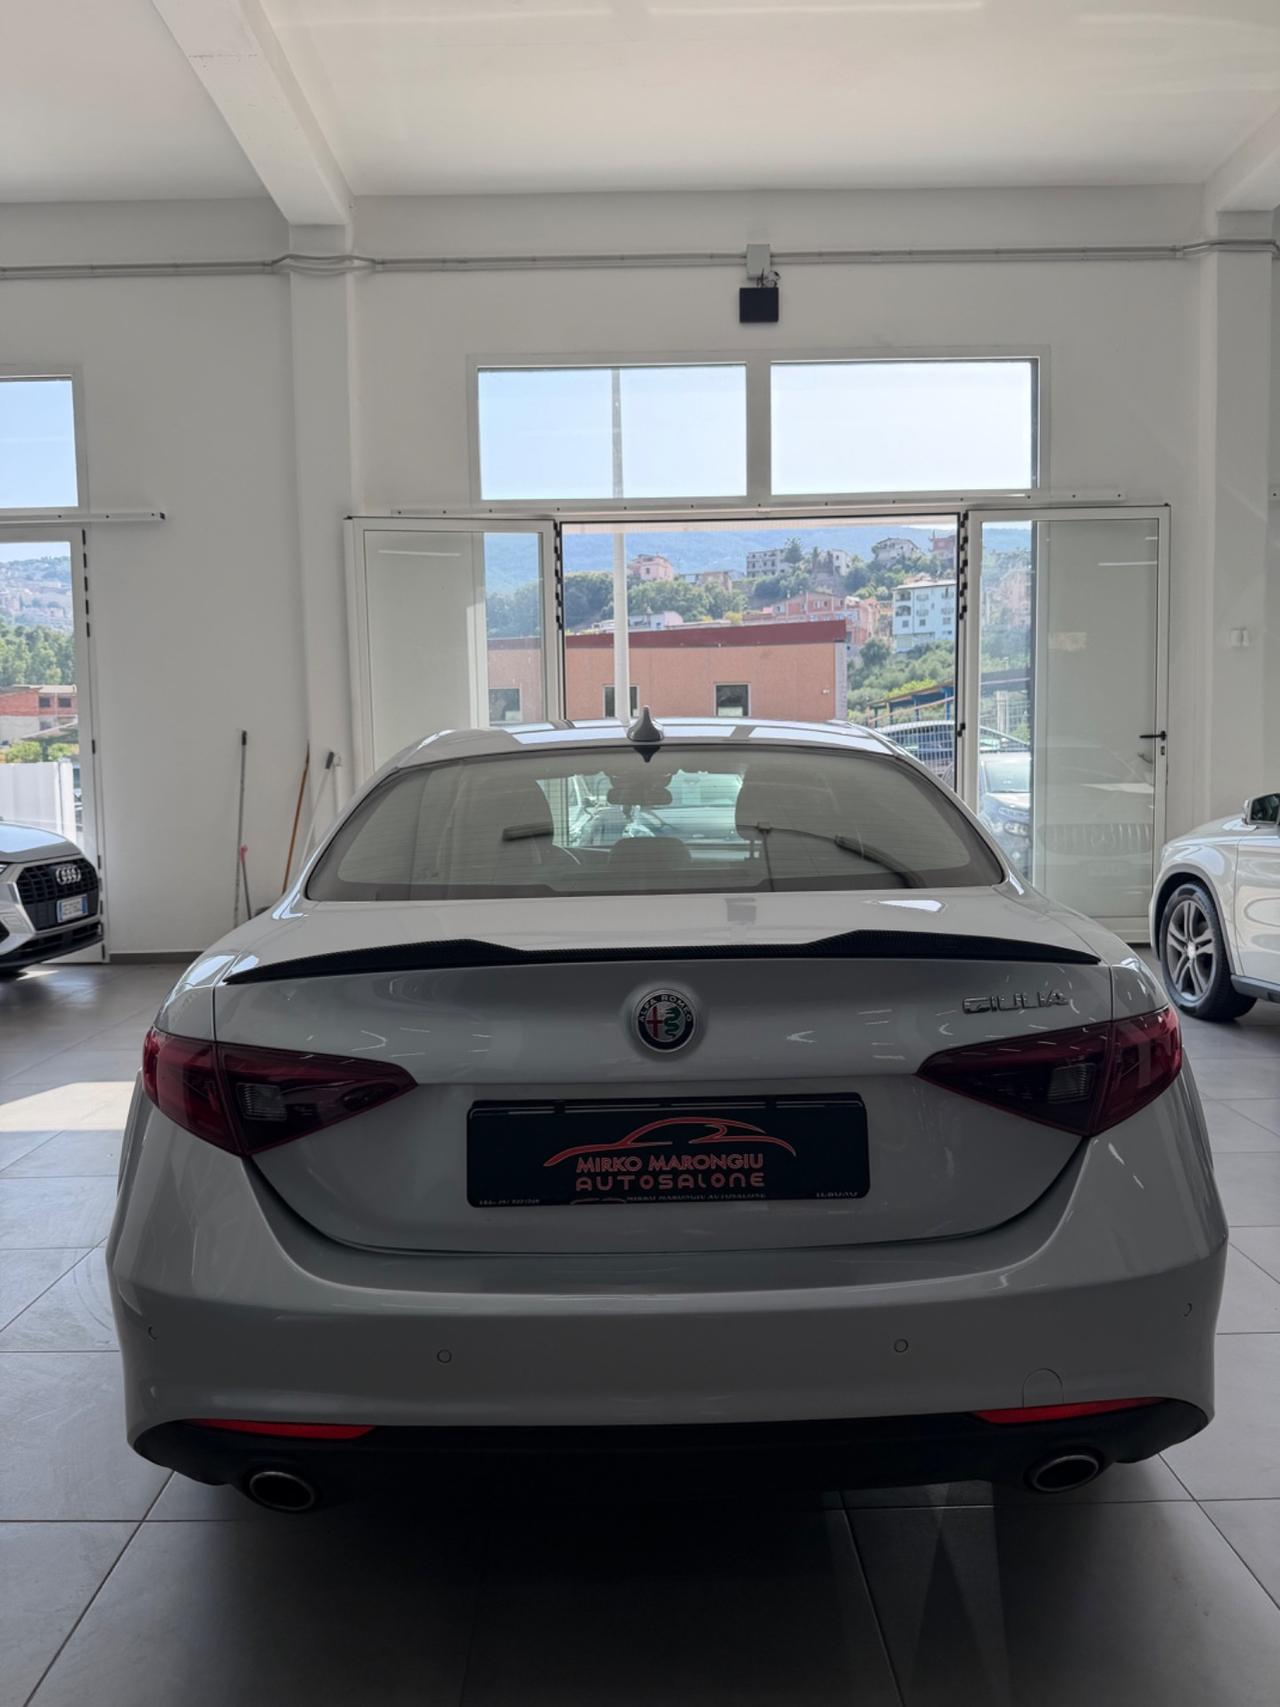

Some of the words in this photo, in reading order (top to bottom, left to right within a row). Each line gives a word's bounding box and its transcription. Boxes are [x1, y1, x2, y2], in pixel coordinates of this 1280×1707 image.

[639, 998, 657, 1022] ALFA
[661, 994, 692, 1022] ROMEO
[962, 989, 1068, 1014] GIULIA
[576, 1155, 643, 1173] MIRKO
[648, 1152, 765, 1172] MARONGIU
[575, 1171, 766, 1192] AUTOSALONE
